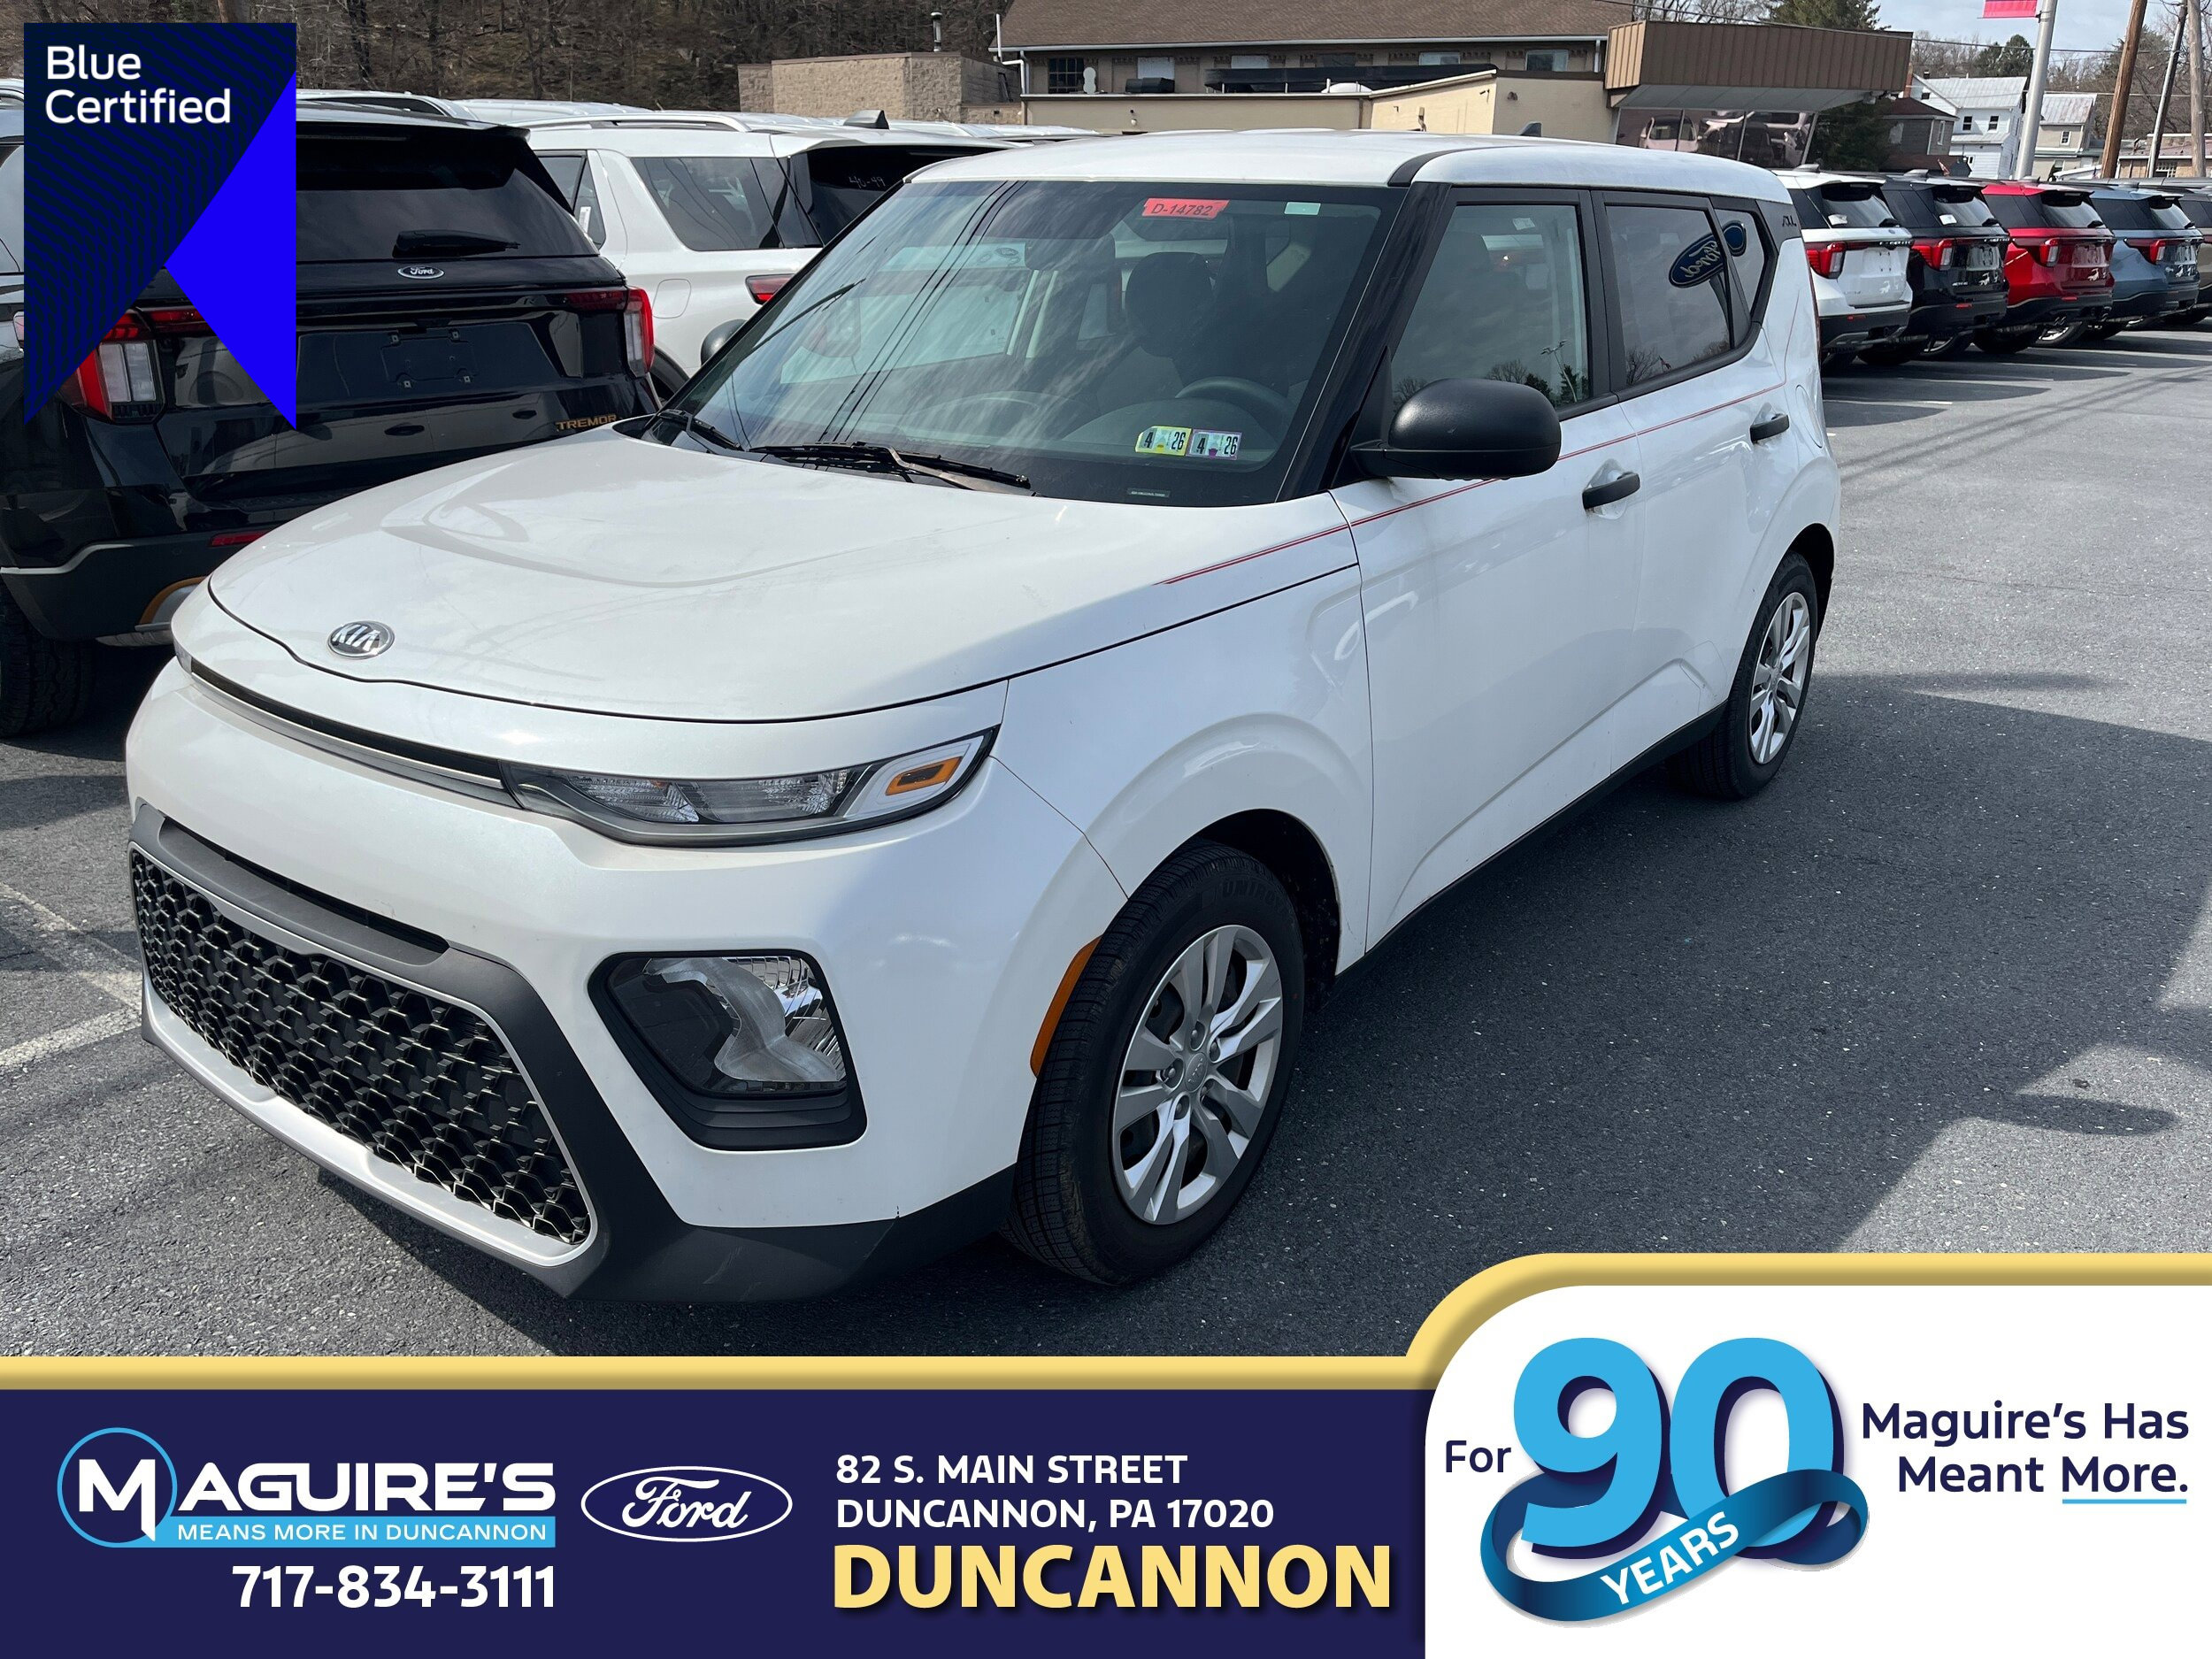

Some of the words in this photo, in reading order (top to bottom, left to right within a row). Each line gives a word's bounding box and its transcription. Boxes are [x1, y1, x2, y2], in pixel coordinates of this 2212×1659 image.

[1150, 204, 1213, 217] D-14782
[410, 266, 434, 275] Ford
[555, 414, 617, 431] TREMOR
[1145, 432, 1154, 449] 4
[1171, 432, 1187, 450] 26
[1197, 438, 1206, 455] 4
[1224, 436, 1239, 455] 26
[332, 624, 380, 652] KIA
